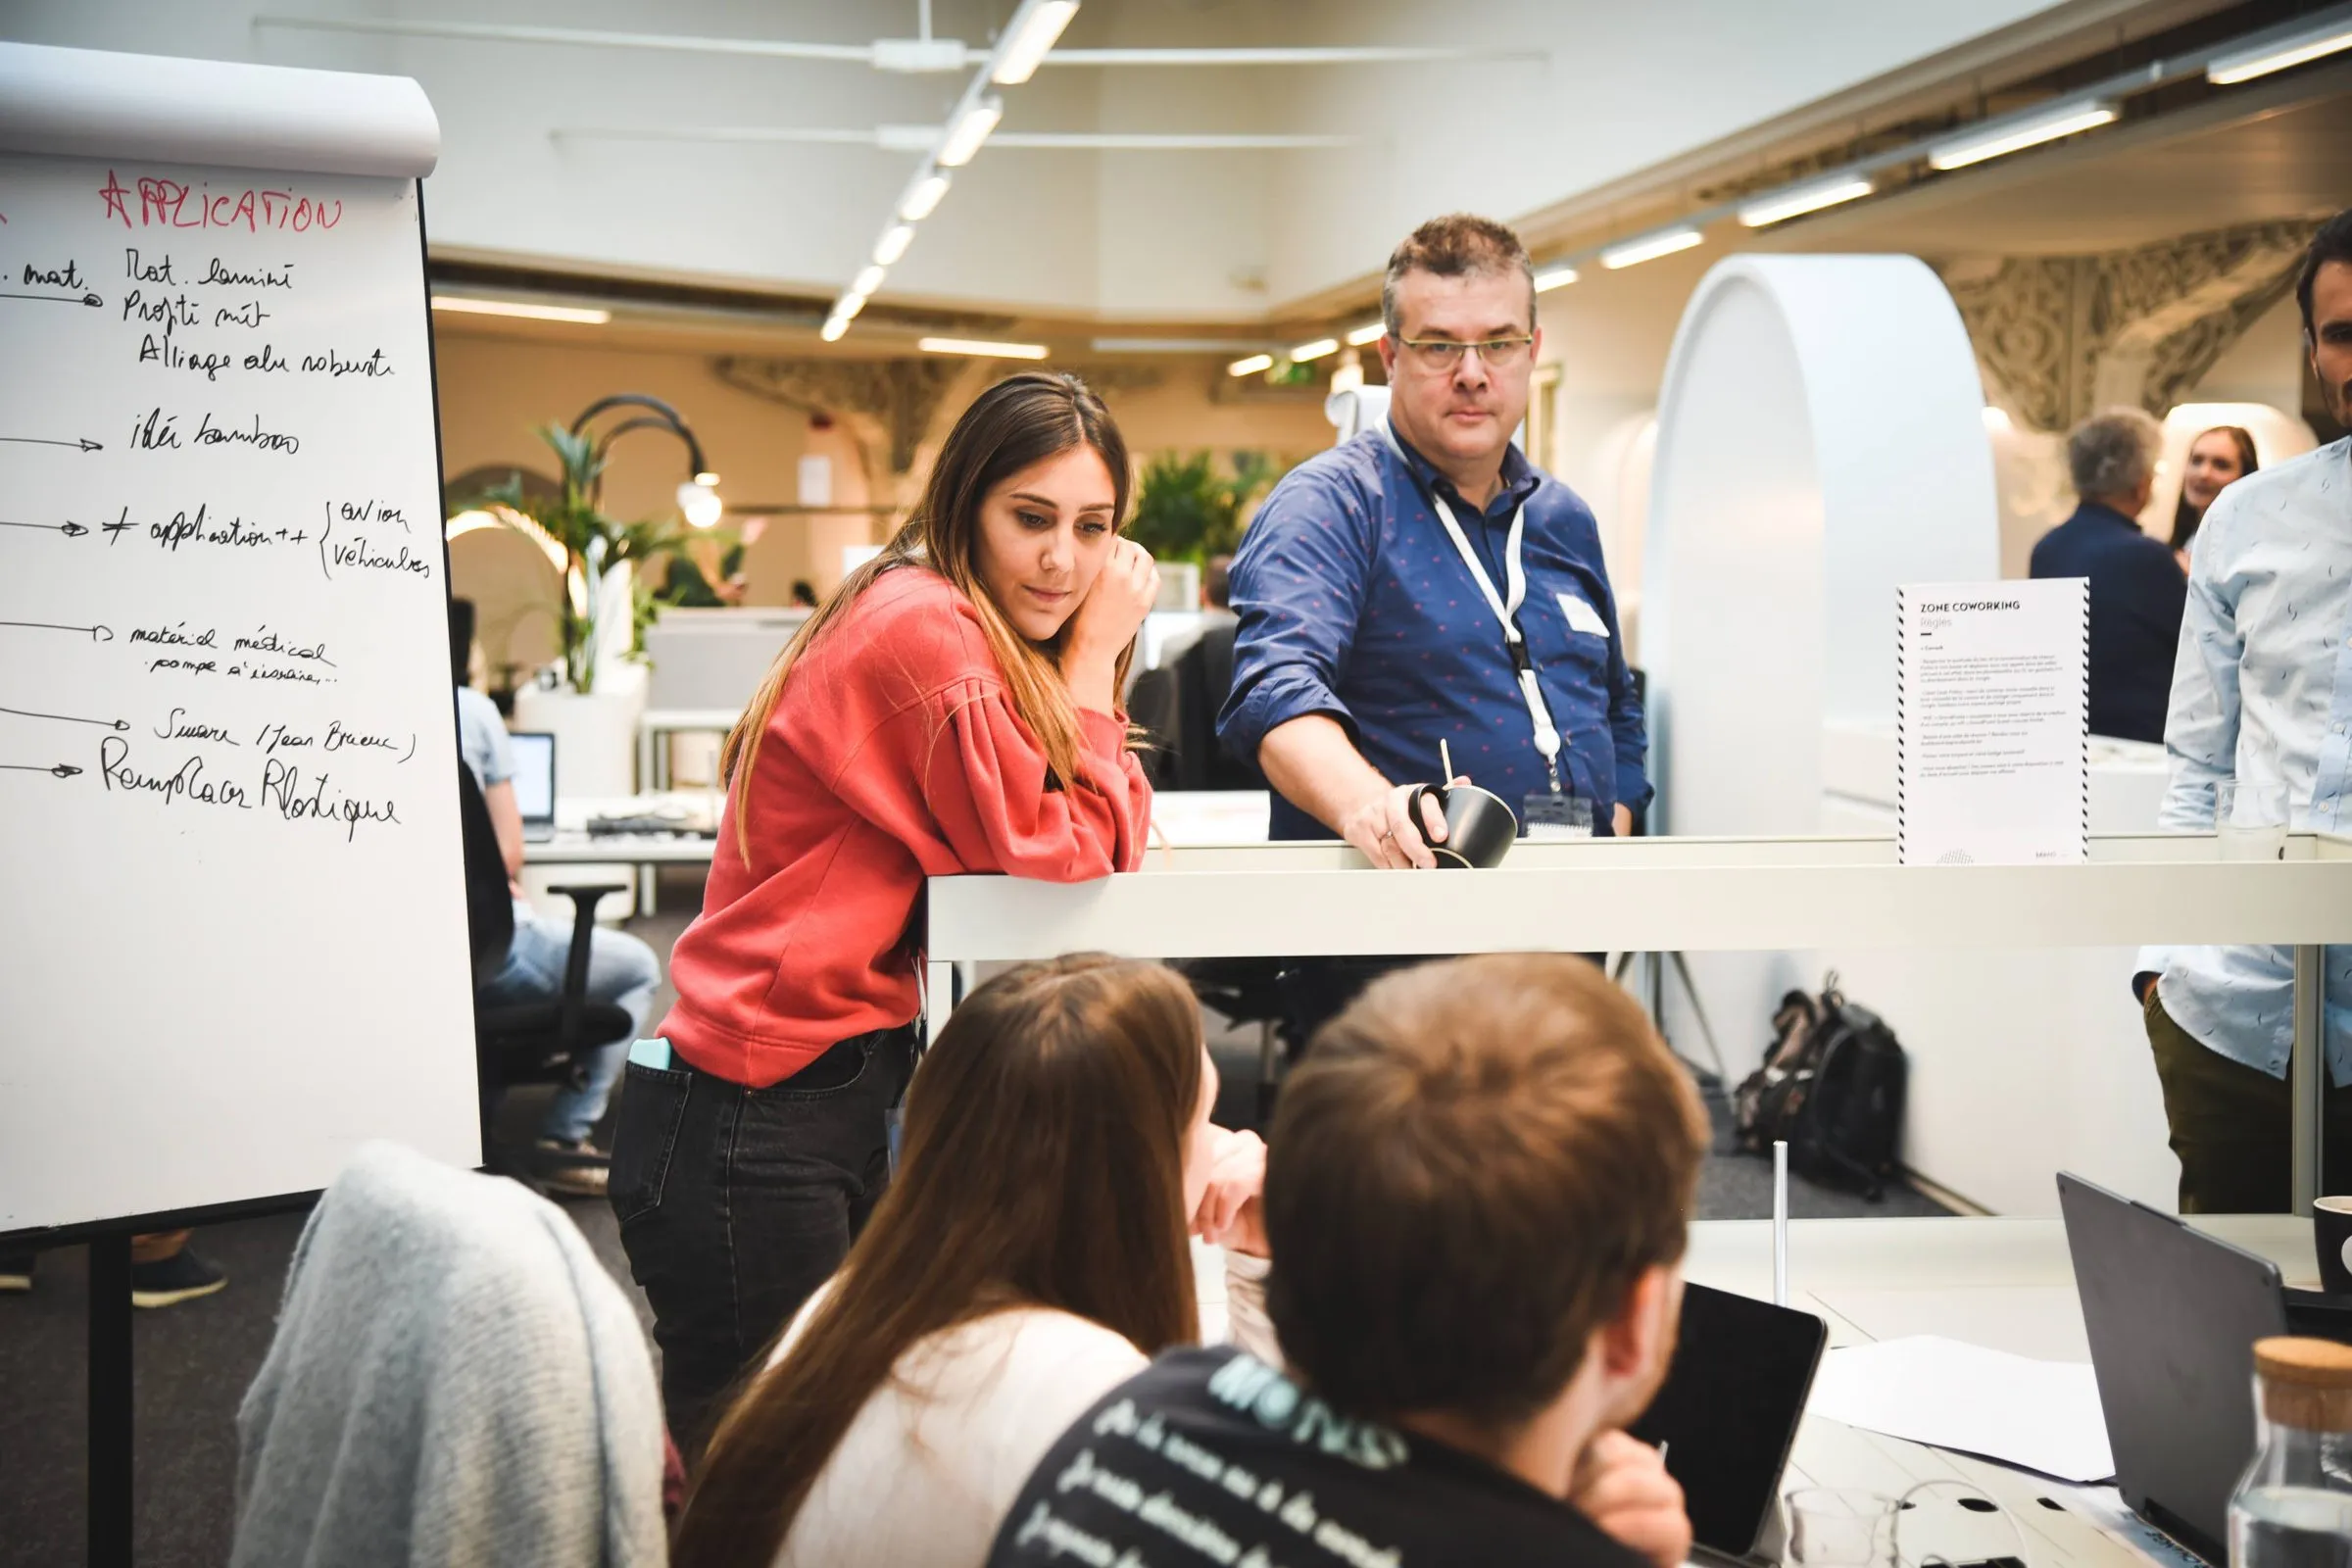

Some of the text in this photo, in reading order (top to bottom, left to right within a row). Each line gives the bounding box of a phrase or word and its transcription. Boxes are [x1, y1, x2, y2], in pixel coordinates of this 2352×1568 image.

[140, 334, 230, 381] Alliage
[1920, 600, 2021, 613] ZONE COWORKING
[234, 624, 338, 668] médical
